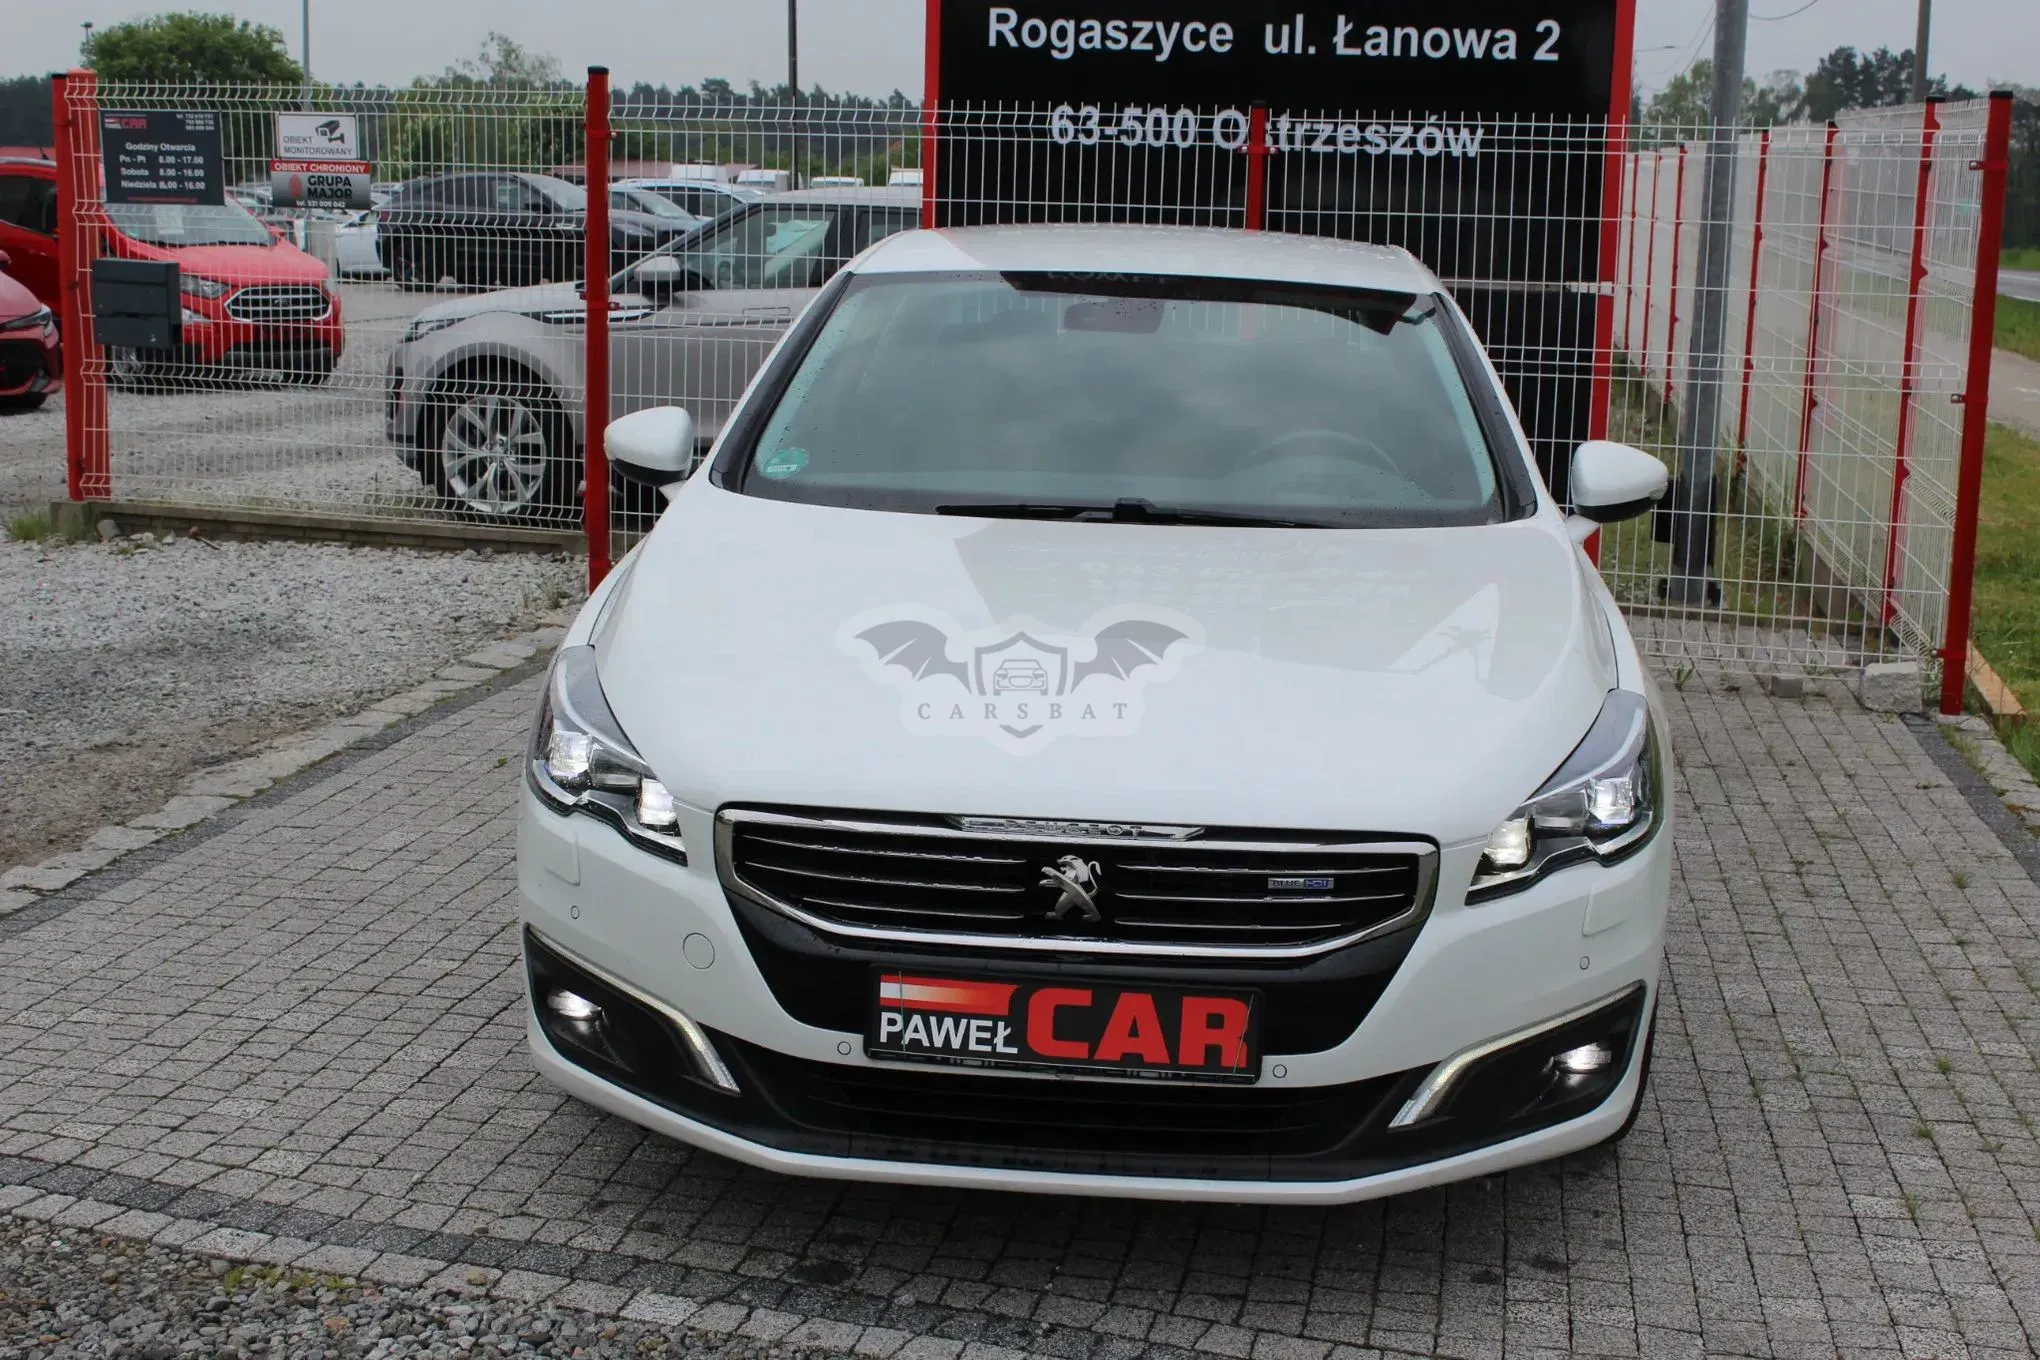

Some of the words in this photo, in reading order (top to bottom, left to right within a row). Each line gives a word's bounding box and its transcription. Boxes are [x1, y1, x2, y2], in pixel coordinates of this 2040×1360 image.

[988, 8, 1234, 61] Rogaszyce
[1264, 14, 1316, 54] ul.
[1334, 15, 1517, 60] Łanowa
[1534, 20, 1560, 61] 2
[1051, 105, 1196, 147] 63-500
[283, 135, 313, 144] OBIEKT
[125, 142, 159, 152] Godziny
[160, 143, 196, 151] Otwarcia
[283, 146, 353, 155] MONITOROWANY
[120, 168, 149, 176] Sobota
[274, 162, 308, 171] OBIEKT
[309, 163, 365, 173] CHRONIONY
[121, 180, 157, 189] Niedziela
[307, 175, 352, 187] GRUPA
[307, 188, 352, 199] MAJOR
[879, 1010, 1018, 1054] PAWEŁ
[1026, 987, 1250, 1068] CAR
